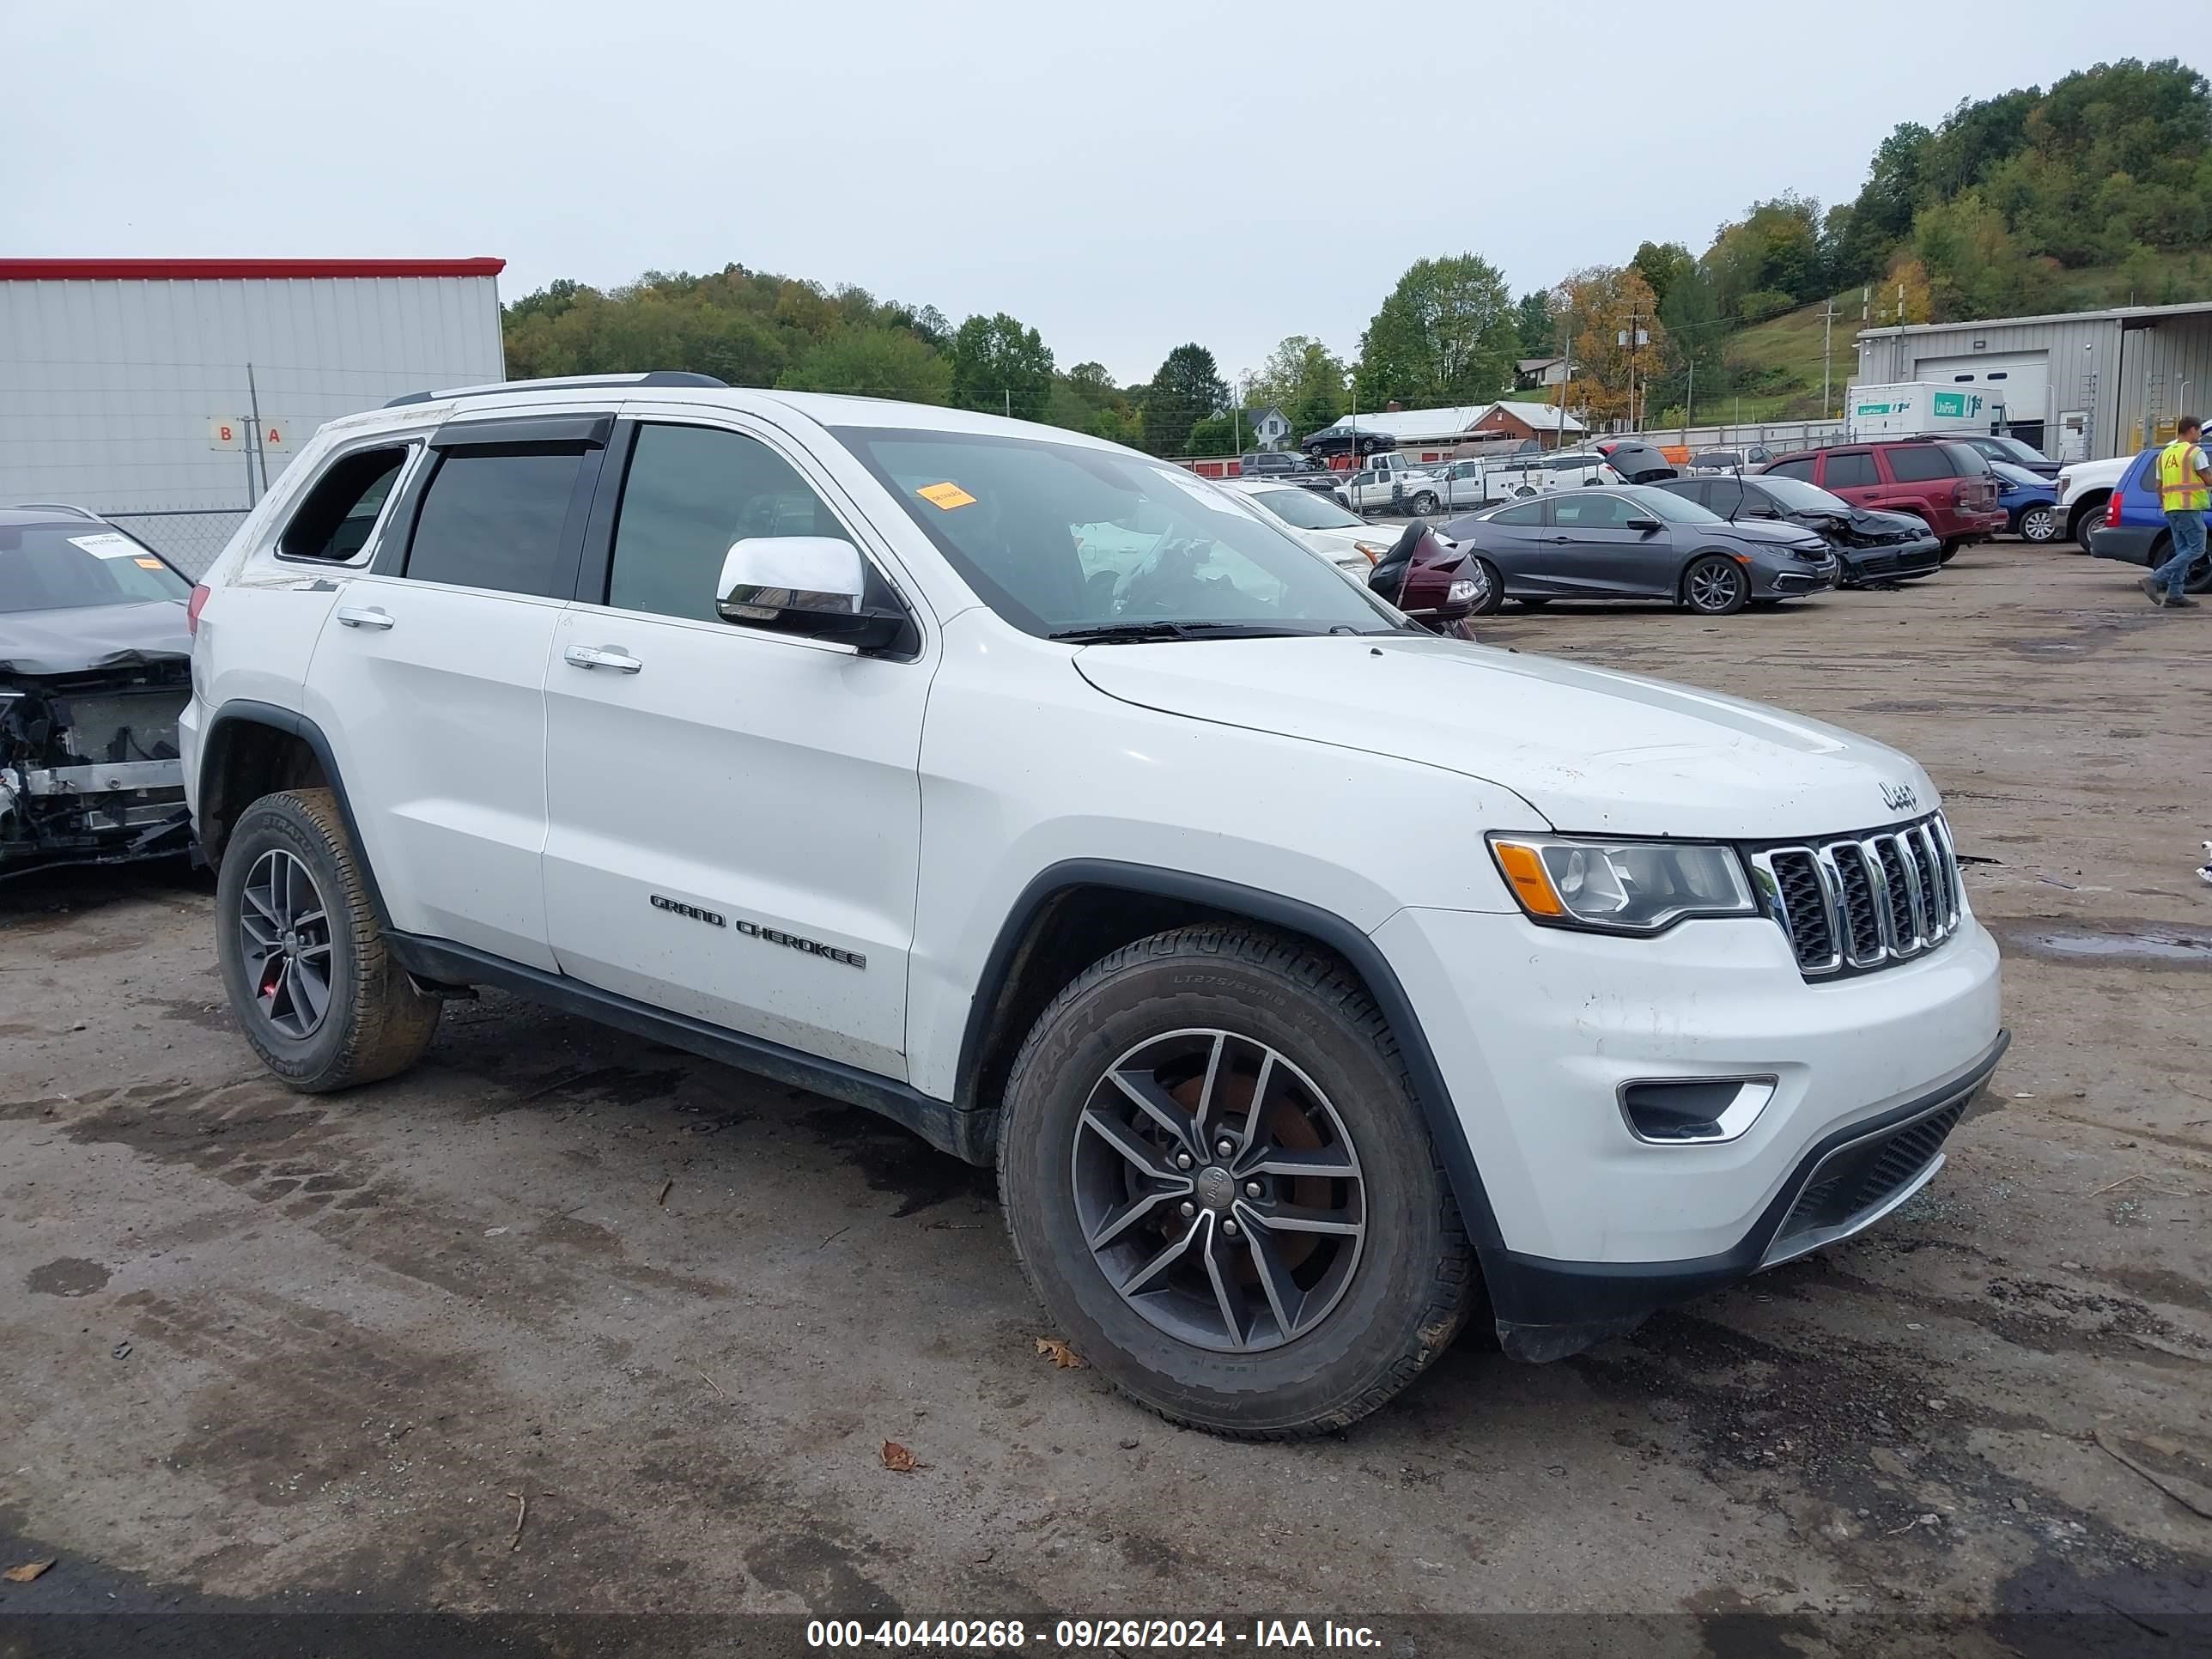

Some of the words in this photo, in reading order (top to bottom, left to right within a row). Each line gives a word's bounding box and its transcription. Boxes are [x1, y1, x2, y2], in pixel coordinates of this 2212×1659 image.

[1936, 401, 1958, 414] UniFirst
[220, 427, 232, 441] B
[268, 428, 281, 443] A
[1878, 781, 1918, 812] Jeep
[650, 893, 727, 929] GRAND
[735, 919, 867, 970] CHEROKEE
